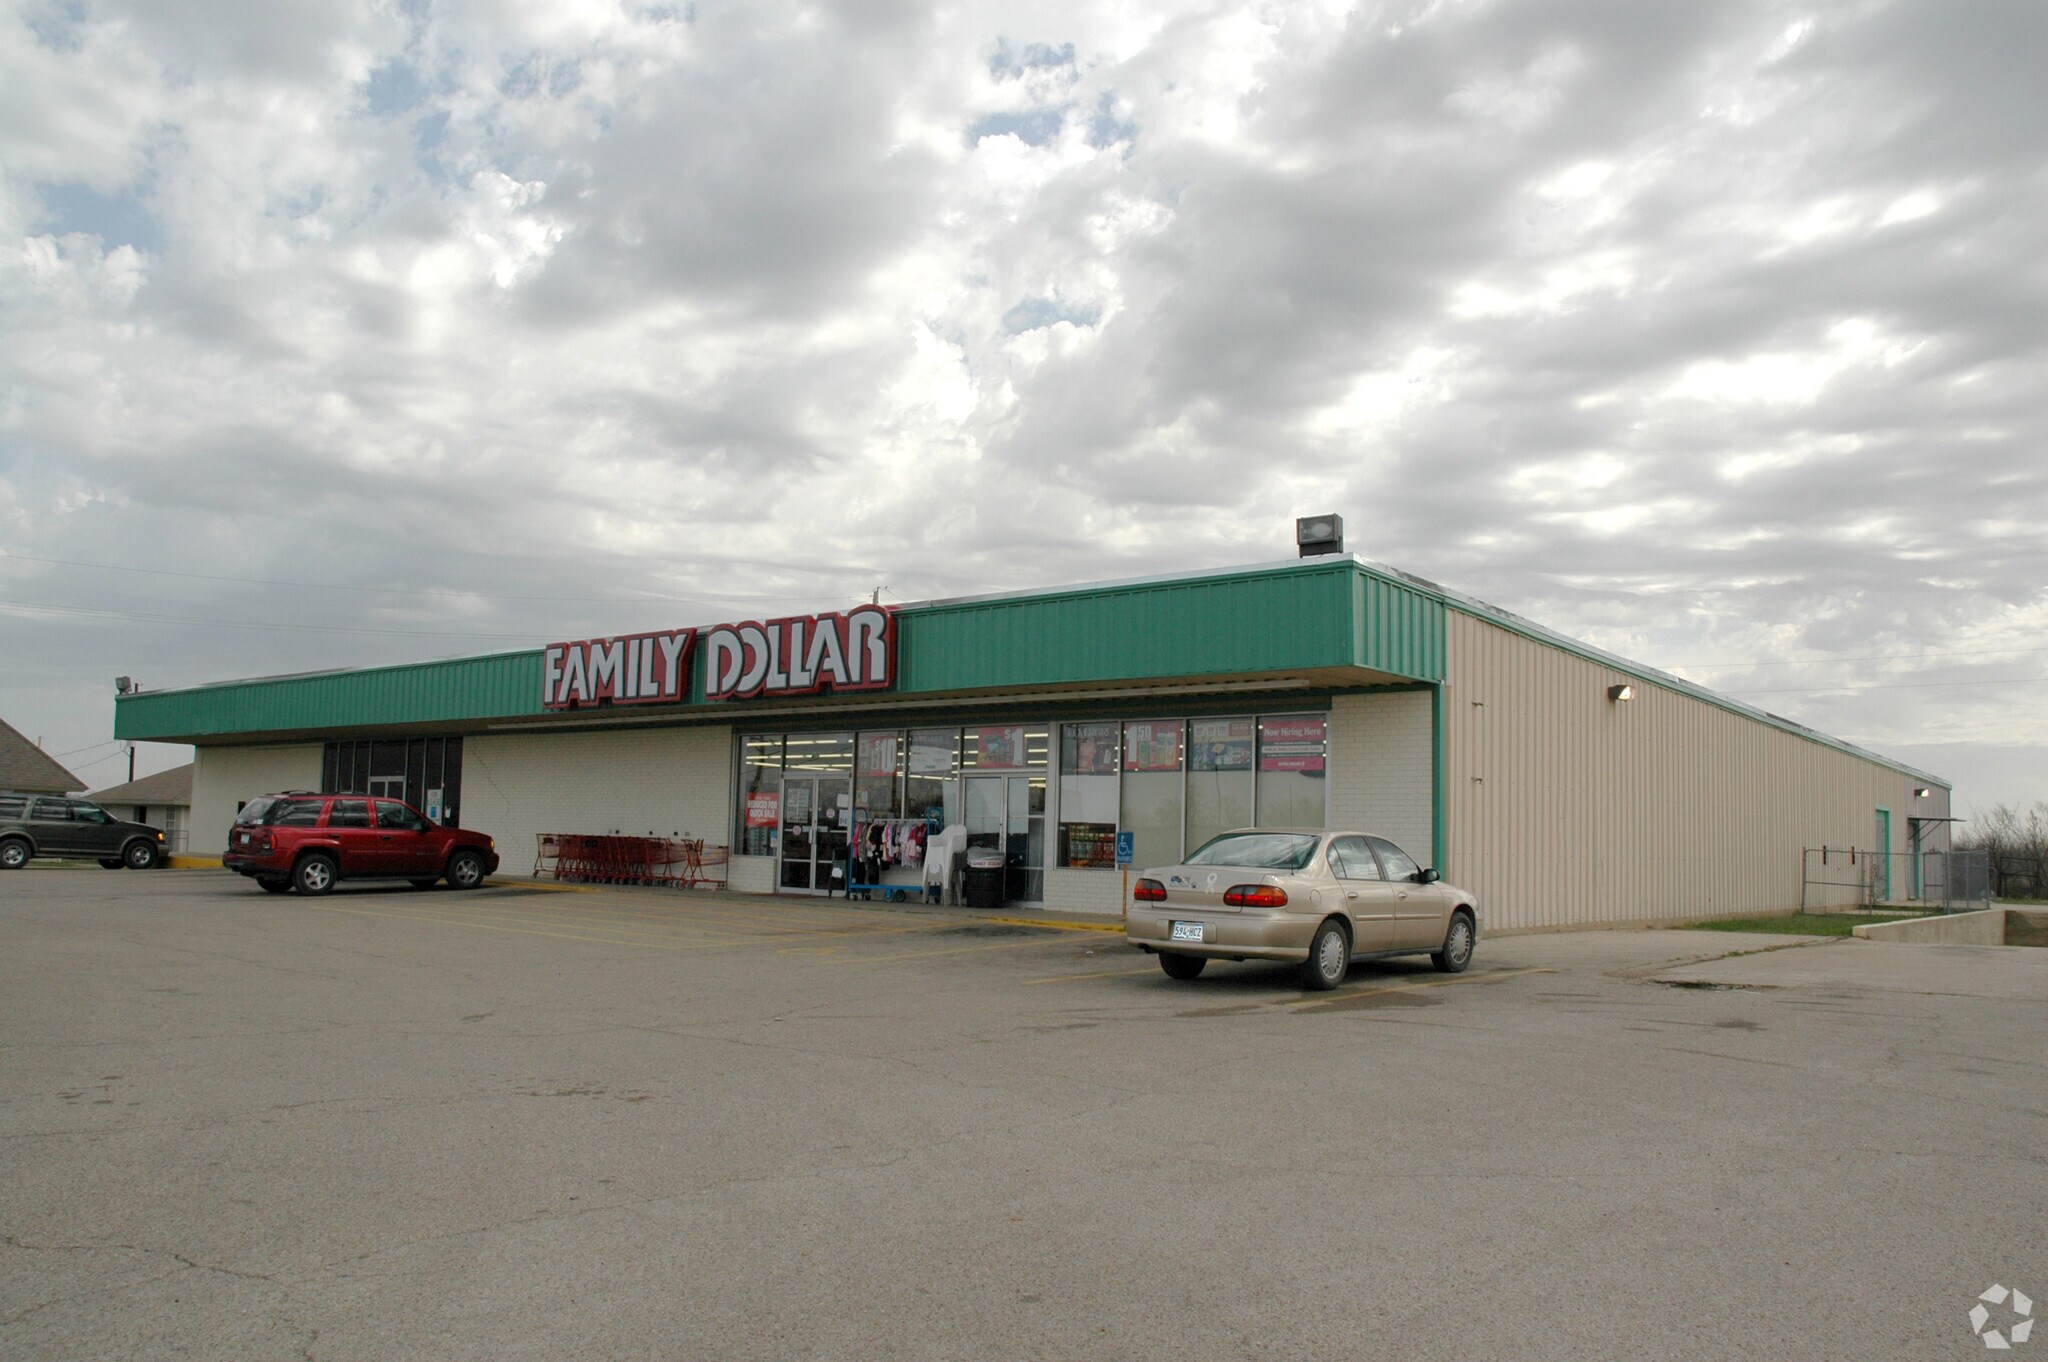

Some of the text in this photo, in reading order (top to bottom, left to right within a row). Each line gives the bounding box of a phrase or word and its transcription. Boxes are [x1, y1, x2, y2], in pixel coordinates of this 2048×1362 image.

[544, 610, 888, 704] FAMILY DOLLAR
[1264, 727, 1322, 738] Now Hiring Here
